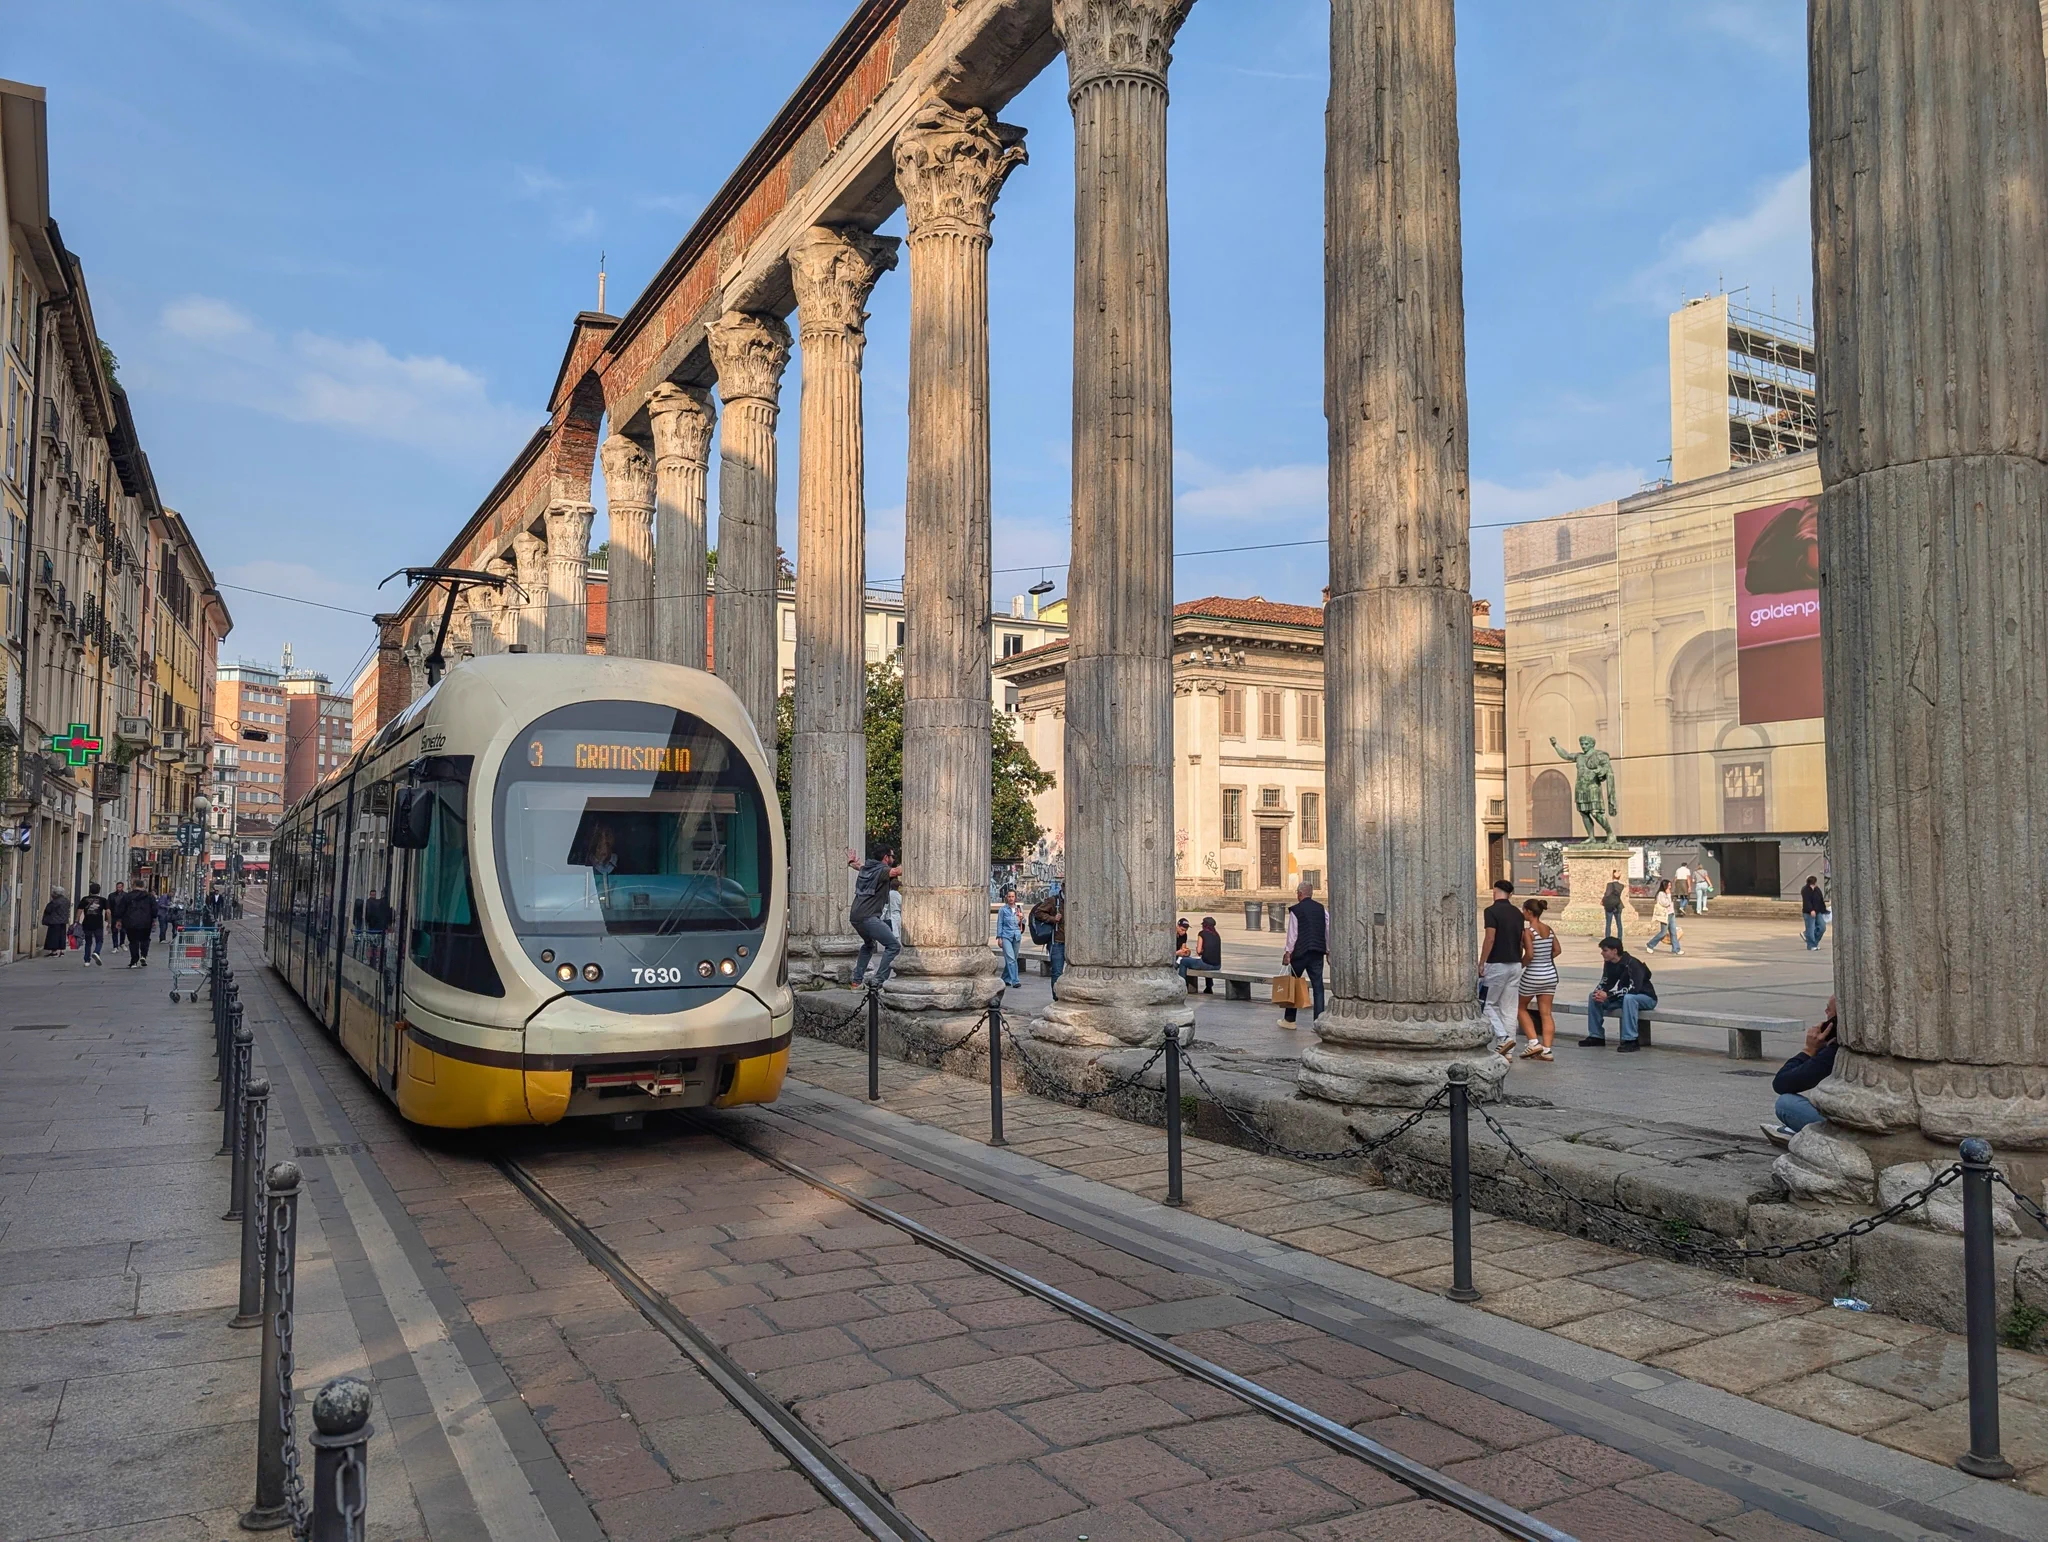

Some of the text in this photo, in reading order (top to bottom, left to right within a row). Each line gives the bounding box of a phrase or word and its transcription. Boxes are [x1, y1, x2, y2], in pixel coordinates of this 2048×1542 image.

[1750, 600, 1820, 627] goldenp
[245, 683, 260, 692] HOTEL
[529, 740, 691, 773] 3 GRATOSOGLIO
[631, 967, 681, 985] 7630
